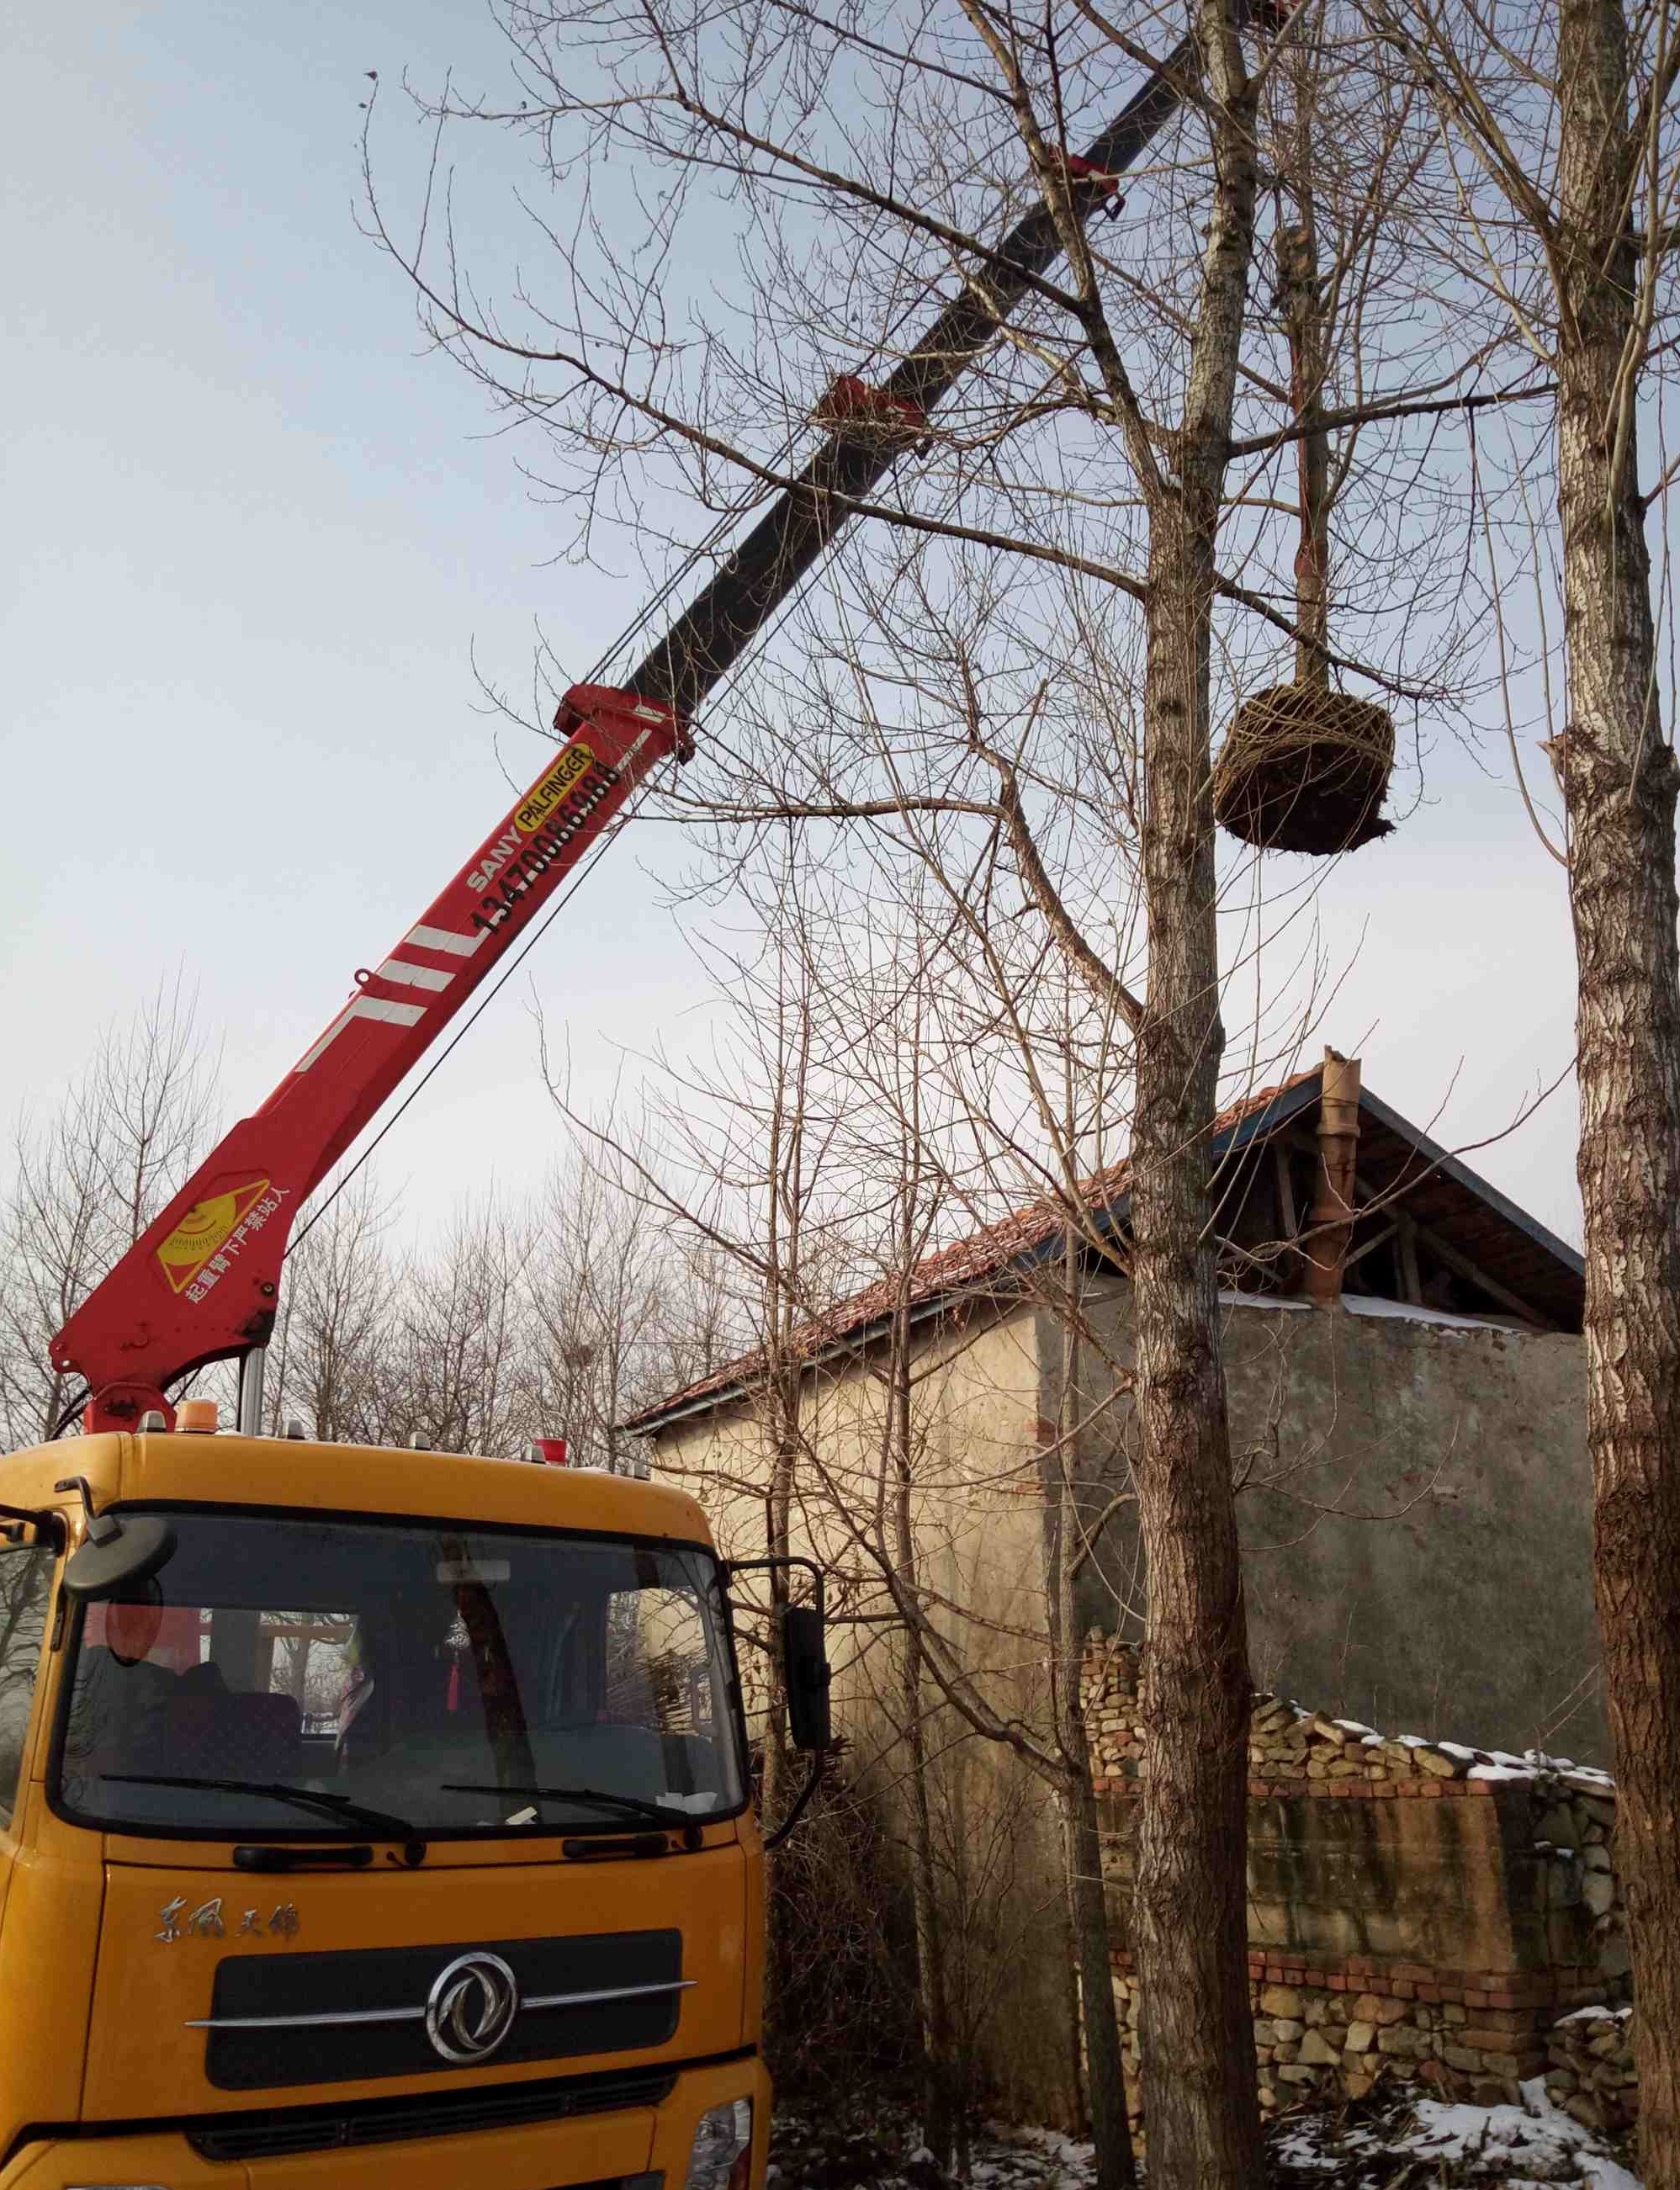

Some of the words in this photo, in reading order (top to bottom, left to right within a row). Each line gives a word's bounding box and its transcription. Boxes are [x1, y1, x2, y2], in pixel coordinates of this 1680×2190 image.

[467, 826, 522, 893] SANY
[518, 747, 590, 829] PALFINGER
[185, 1186, 291, 1303] 起重臂下严禁站人
